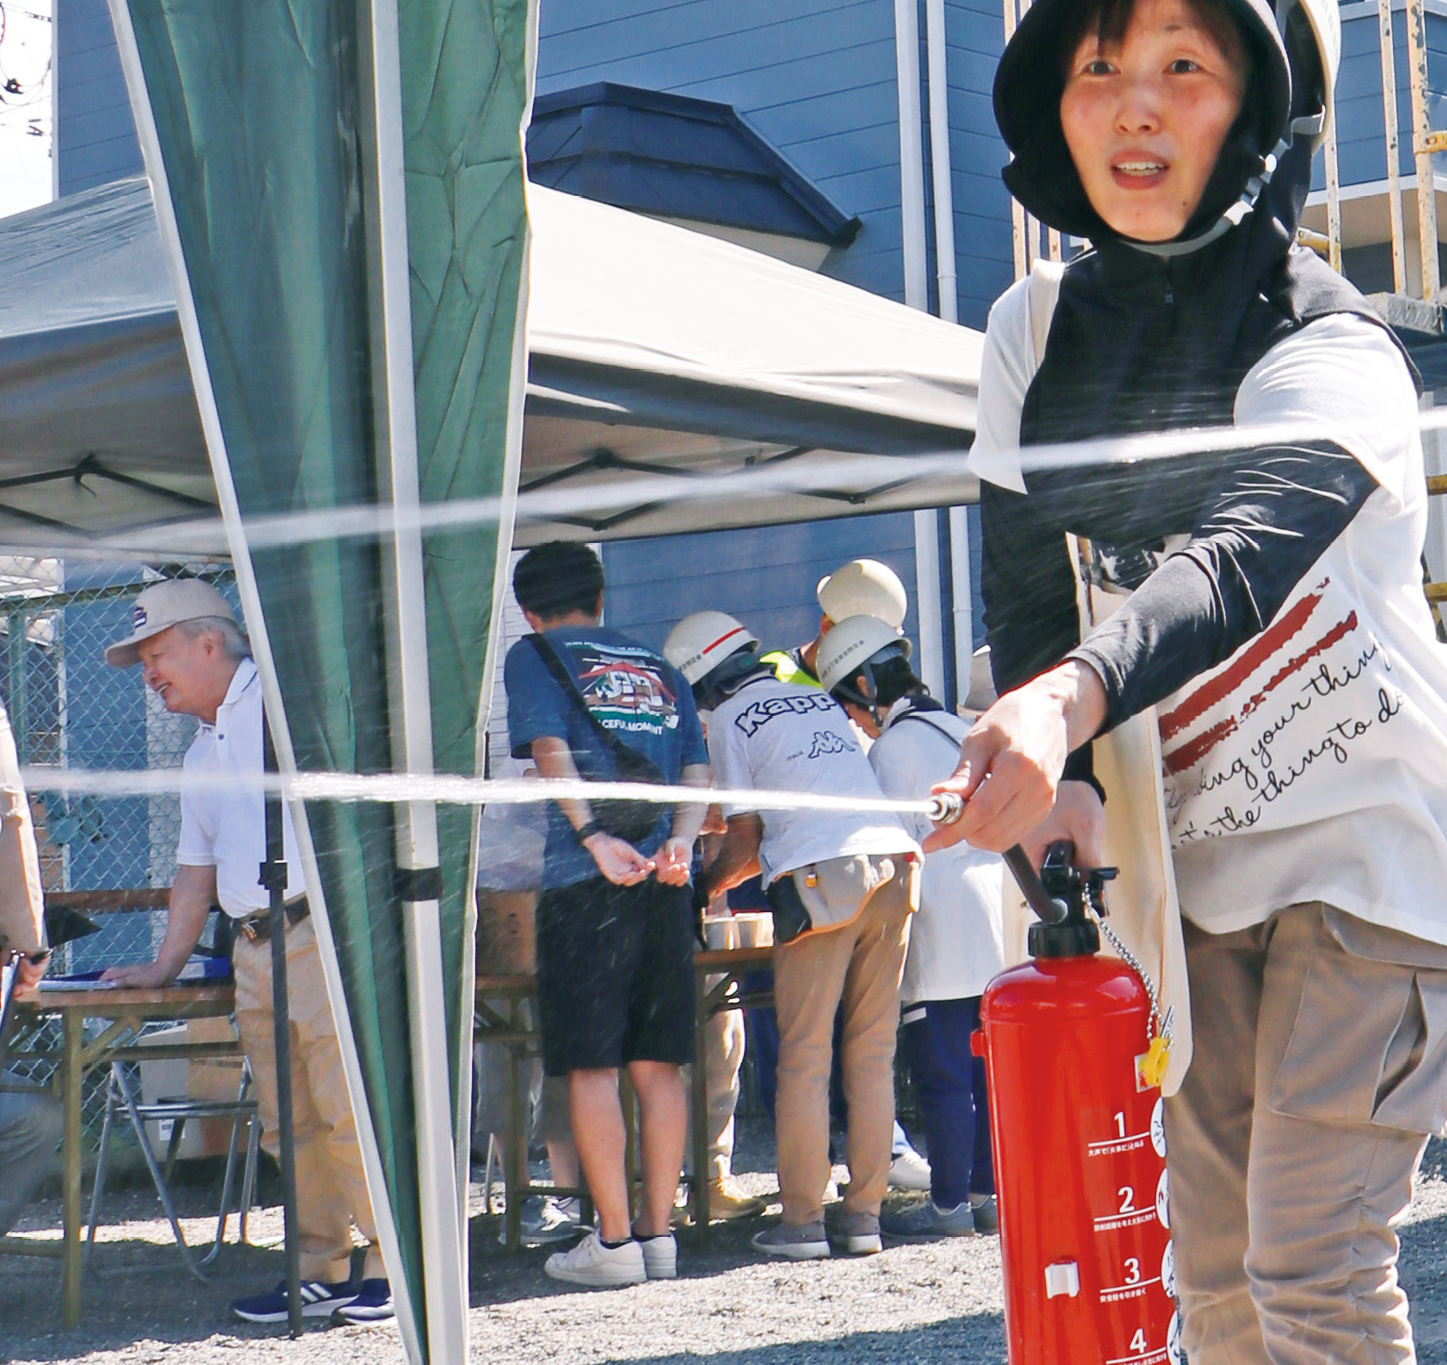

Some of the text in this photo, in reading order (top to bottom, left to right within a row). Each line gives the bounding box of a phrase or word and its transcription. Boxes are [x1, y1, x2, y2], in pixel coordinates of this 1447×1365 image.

[1209, 805, 1261, 832] the
[1327, 718, 1373, 740] to
[1114, 1111, 1126, 1138] 1
[1117, 1186, 1135, 1214] 2
[1124, 1257, 1141, 1285] 3
[1129, 1327, 1147, 1354] 4
